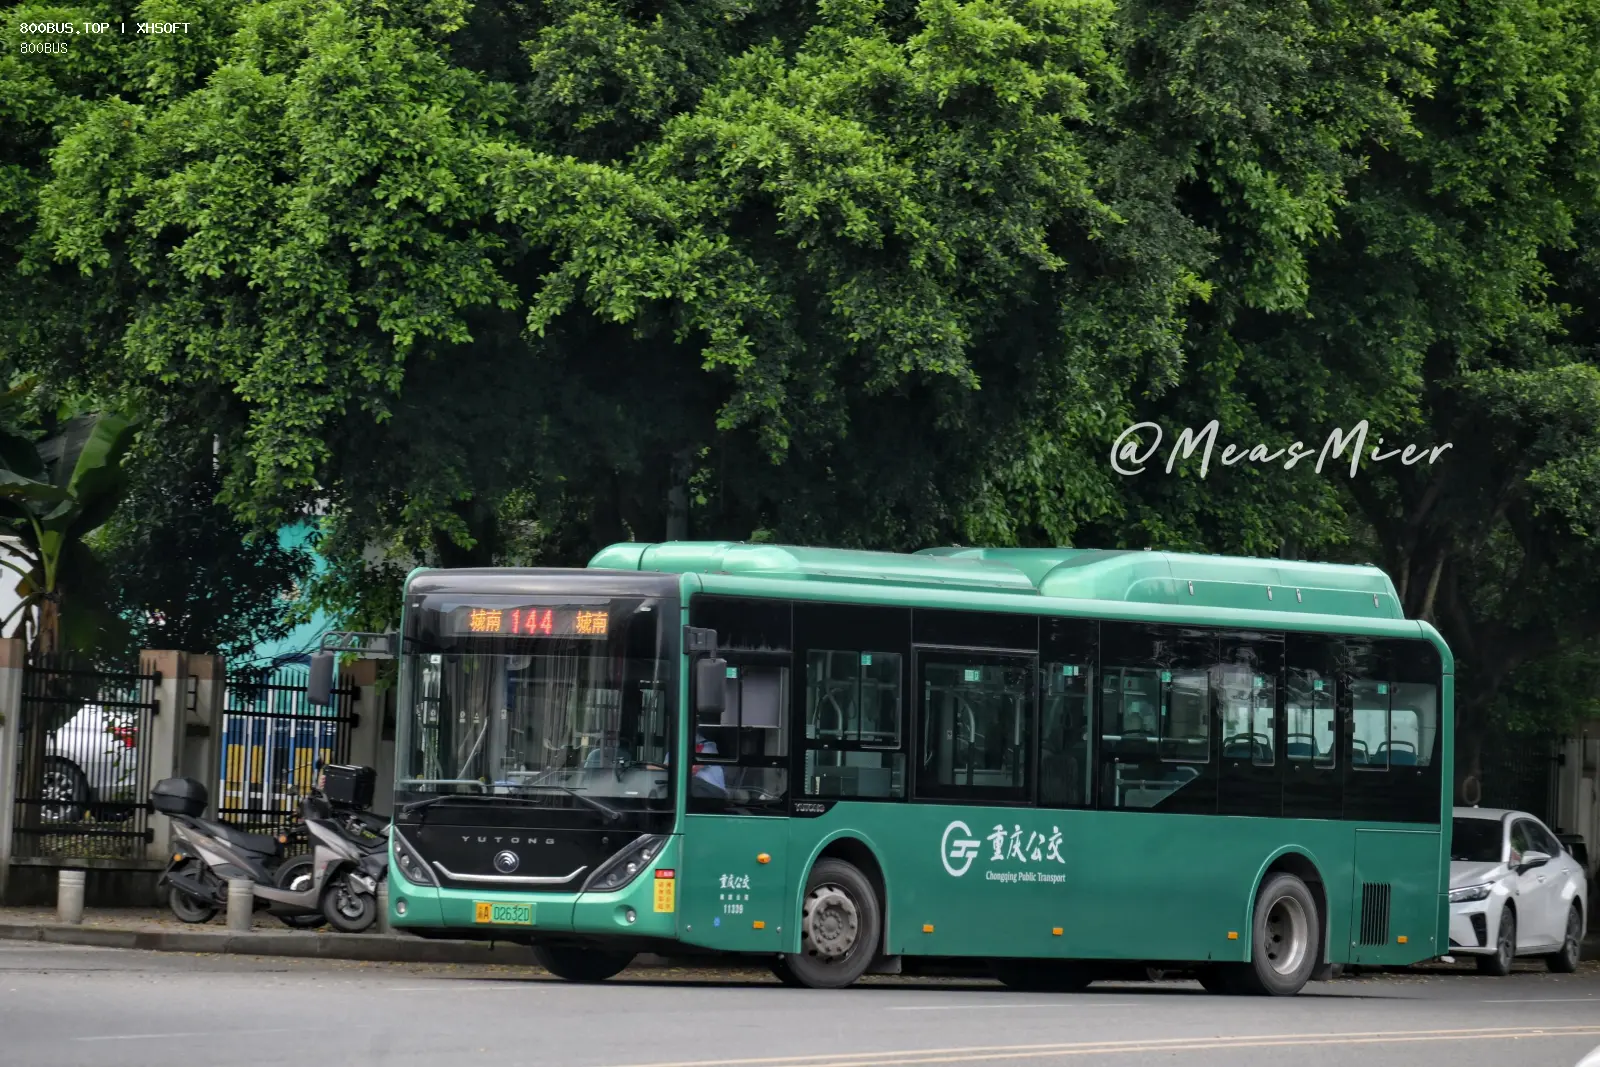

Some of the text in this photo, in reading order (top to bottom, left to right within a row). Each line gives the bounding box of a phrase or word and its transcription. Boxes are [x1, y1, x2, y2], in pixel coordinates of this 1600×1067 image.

[470, 607, 609, 635] 城南 144 城南
[461, 835, 555, 845] YUTONG
[986, 824, 1066, 864] 重庆公交
[719, 873, 751, 890] 重庆公交
[985, 870, 1066, 885] Chongqing Public Transport
